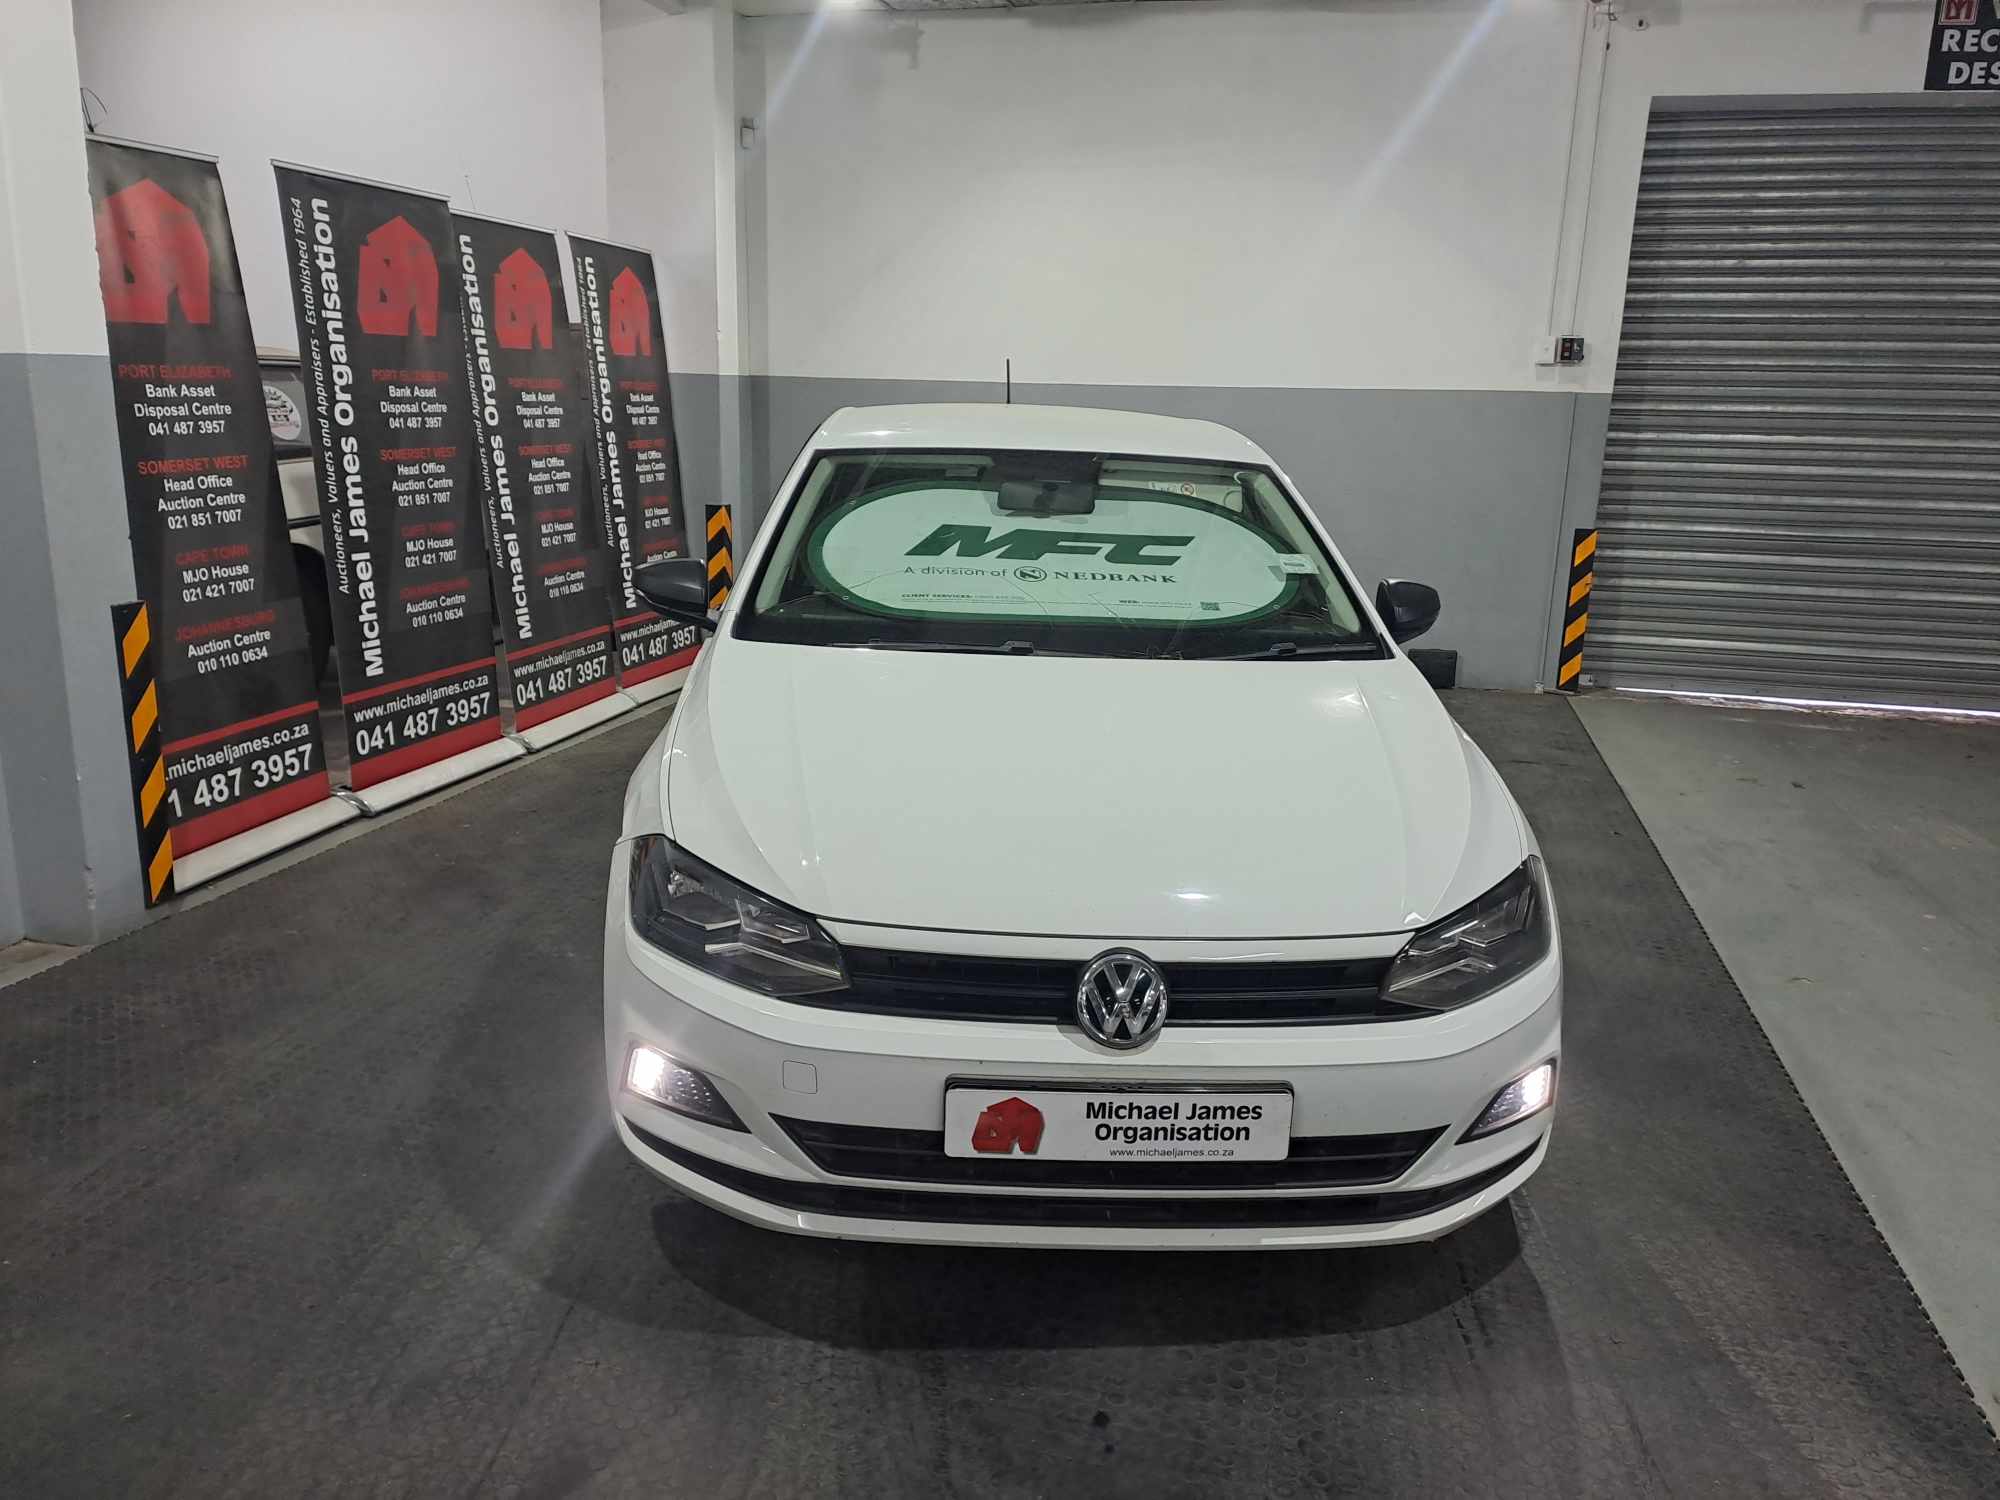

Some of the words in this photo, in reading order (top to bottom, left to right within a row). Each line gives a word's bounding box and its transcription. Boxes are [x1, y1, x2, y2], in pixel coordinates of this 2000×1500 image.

[1941, 28, 2000, 53] REC
[291, 196, 306, 235] 1964
[298, 240, 317, 325] Established
[311, 198, 354, 427] Organisation
[459, 234, 499, 427] Organisation
[585, 256, 613, 424] Organisation
[117, 364, 156, 379] PORT
[311, 337, 329, 415] Appraisers
[145, 384, 177, 398] Bank
[180, 384, 215, 397] Asset
[388, 385, 411, 398] Bank
[413, 385, 437, 398] Asset
[466, 353, 480, 417] Appraisers
[134, 403, 188, 419] Disposal
[192, 402, 231, 416] Centre
[380, 401, 419, 415] Disposal
[421, 402, 447, 413] Centre
[149, 423, 169, 436] 041
[173, 422, 193, 434] 487
[199, 420, 224, 433] 3957
[320, 416, 332, 446] and
[389, 417, 405, 429] 041
[407, 417, 422, 428] 487
[425, 417, 442, 428] 3957
[473, 420, 484, 444] and
[138, 457, 209, 475] SOMERSET
[214, 455, 248, 468] WEST
[325, 451, 338, 503] Valuers
[397, 463, 419, 475] Head
[421, 462, 445, 474] Office
[480, 447, 491, 491] Valuers
[606, 431, 624, 510] James
[164, 478, 194, 492] Head
[198, 475, 232, 489] Office
[340, 436, 369, 543] James
[392, 480, 426, 492] Auction
[427, 478, 453, 490] Centre
[491, 435, 514, 525] James
[158, 496, 204, 512] Auction
[207, 493, 246, 506] Centre
[398, 494, 413, 507] 021
[415, 493, 430, 505] 851
[433, 492, 450, 504] 7007
[168, 515, 188, 530] 021
[192, 514, 211, 526] 851
[215, 509, 241, 523] 7007
[406, 540, 425, 552] MJO
[427, 538, 454, 549] House
[487, 497, 504, 569] Auctioneers,
[904, 524, 1195, 566] MFC
[332, 508, 350, 594] Auctioneers,
[405, 556, 420, 568] 021
[422, 553, 436, 565] 421
[439, 550, 457, 562] 7007
[614, 516, 638, 609] Michael
[183, 568, 208, 584] MJO
[212, 564, 249, 579] House
[503, 533, 533, 640] Michael
[903, 566, 914, 575] A
[921, 566, 985, 576] division
[990, 567, 1008, 577] of
[1054, 571, 1177, 583] NEDBANK
[183, 588, 201, 602] 021
[206, 583, 225, 598] 421
[229, 578, 255, 594] 7007
[352, 551, 384, 678] Michael
[406, 600, 438, 614] Auction
[439, 594, 466, 607] Centre
[412, 616, 427, 628] 010
[429, 611, 443, 624] 110
[445, 607, 463, 620] 0634
[620, 619, 680, 642] www.michaeljam
[188, 639, 231, 658] Auction
[234, 629, 271, 647] Centre
[622, 642, 645, 666] 041
[649, 635, 667, 657] 487
[671, 625, 695, 650] 3957
[198, 660, 216, 674] 010
[220, 653, 239, 668] 110
[242, 646, 268, 663] 0634
[513, 640, 605, 678] www.michaeljames.co.za
[516, 677, 544, 706] 041
[548, 666, 572, 693] 487
[576, 655, 607, 684] 3957
[353, 674, 489, 723] www.michaeljames.co.za
[356, 720, 395, 756] 041
[403, 707, 439, 739] 487
[446, 691, 491, 726] 3957
[167, 788, 183, 818] 1
[194, 767, 242, 808] 487
[251, 743, 312, 788] 3957
[1085, 1102, 1179, 1120] Michael
[1186, 1102, 1263, 1120] James
[1095, 1123, 1250, 1144] Organisation
[1109, 1148, 1235, 1159] www.michaeljames.co.za
